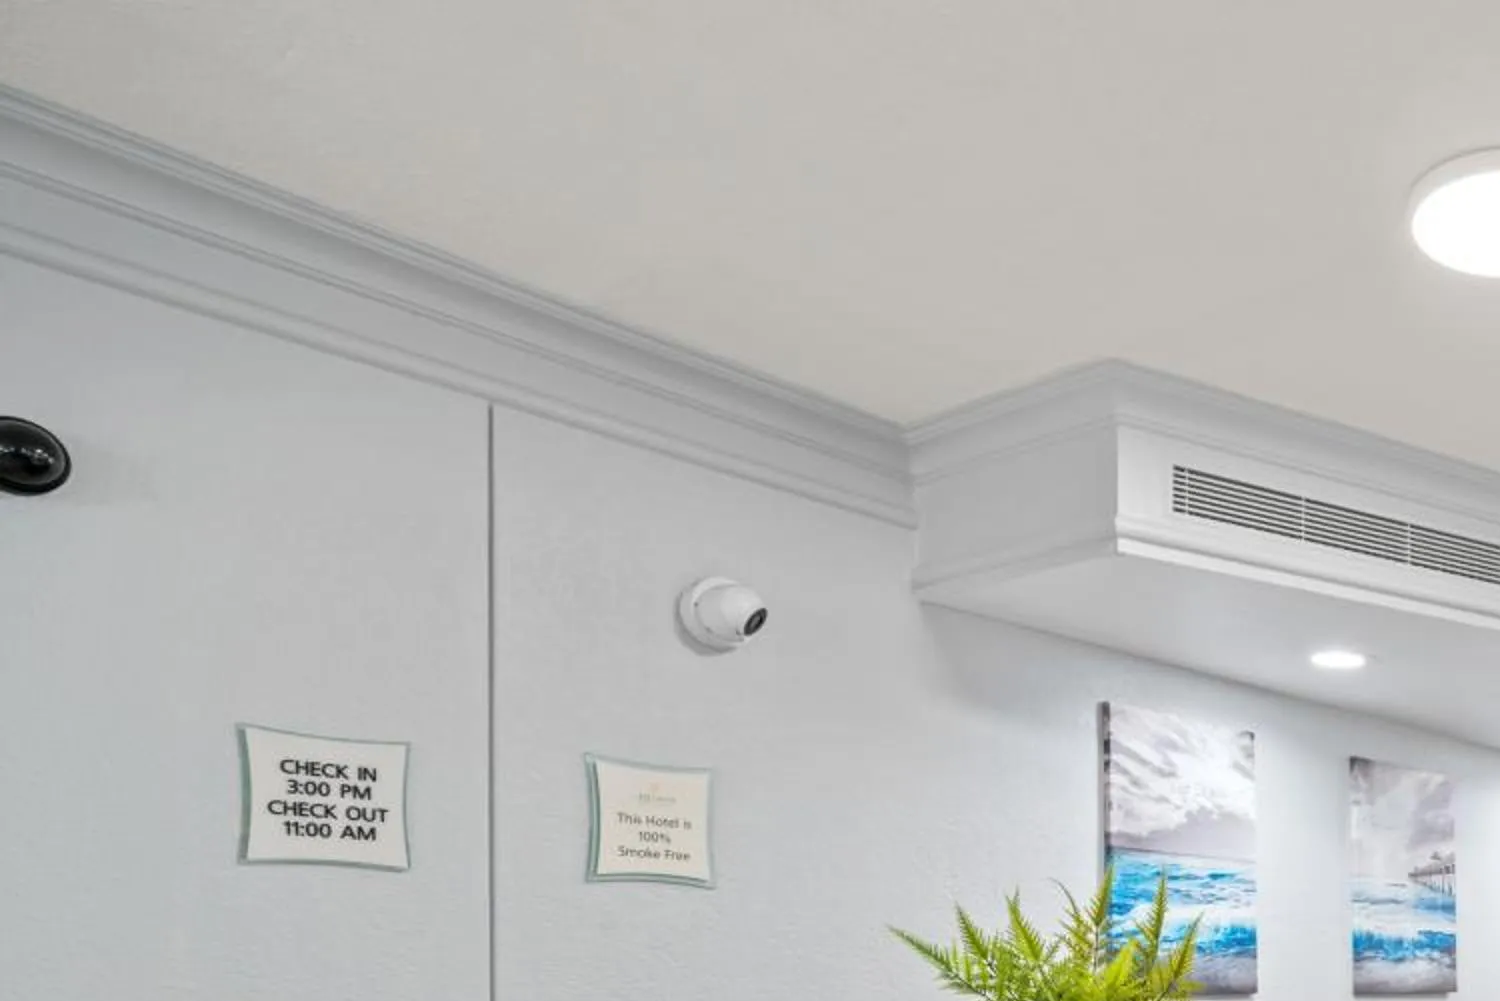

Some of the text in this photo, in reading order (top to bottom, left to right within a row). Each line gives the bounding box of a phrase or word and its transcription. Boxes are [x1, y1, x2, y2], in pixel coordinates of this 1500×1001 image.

[280, 759, 377, 782] CHECK IN
[287, 779, 372, 800] 3:00 PM
[267, 800, 389, 822] CHECK OUT
[616, 811, 693, 831] This Hotel is
[283, 820, 377, 841] 11:00 AM
[638, 831, 672, 844] 100%
[617, 844, 691, 861] Smoke Free
